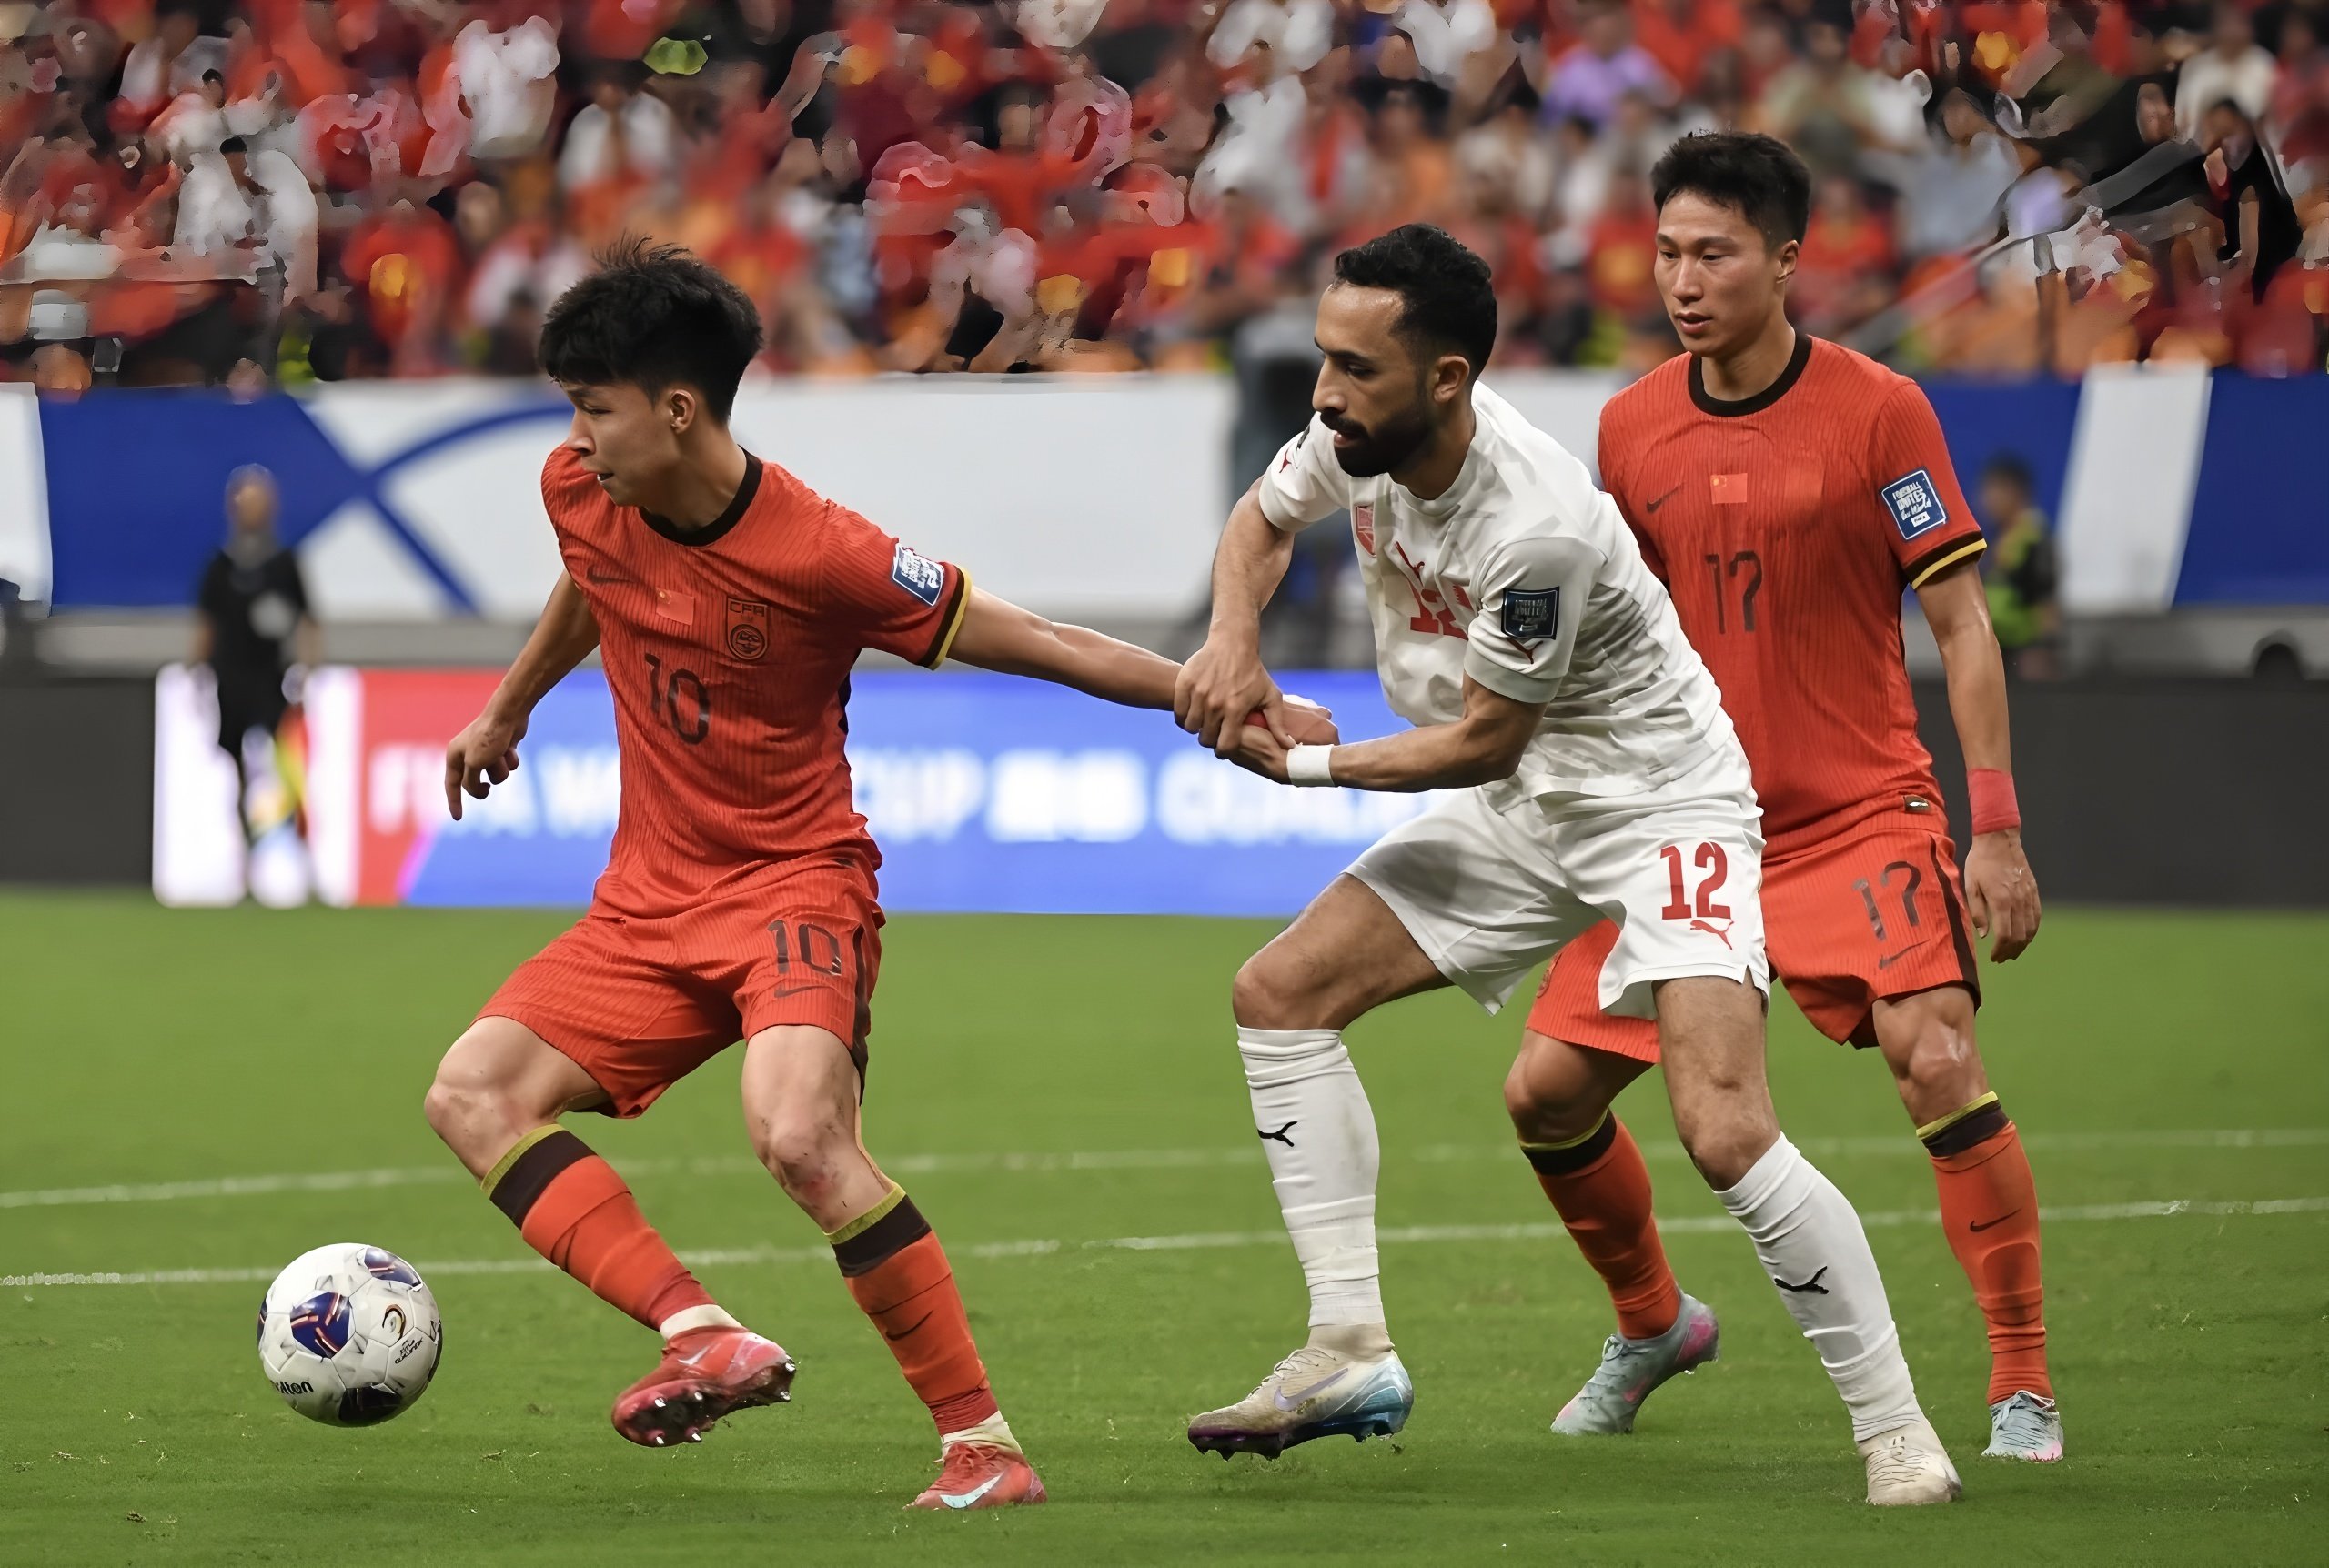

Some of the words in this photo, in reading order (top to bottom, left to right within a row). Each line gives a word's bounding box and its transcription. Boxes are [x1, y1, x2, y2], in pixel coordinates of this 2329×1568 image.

[729, 601, 766, 618] CFA
[1704, 550, 1763, 635] 17
[644, 652, 711, 745] 10
[1659, 841, 1731, 920] 12
[1852, 860, 1921, 942] 17
[767, 919, 842, 976] 10
